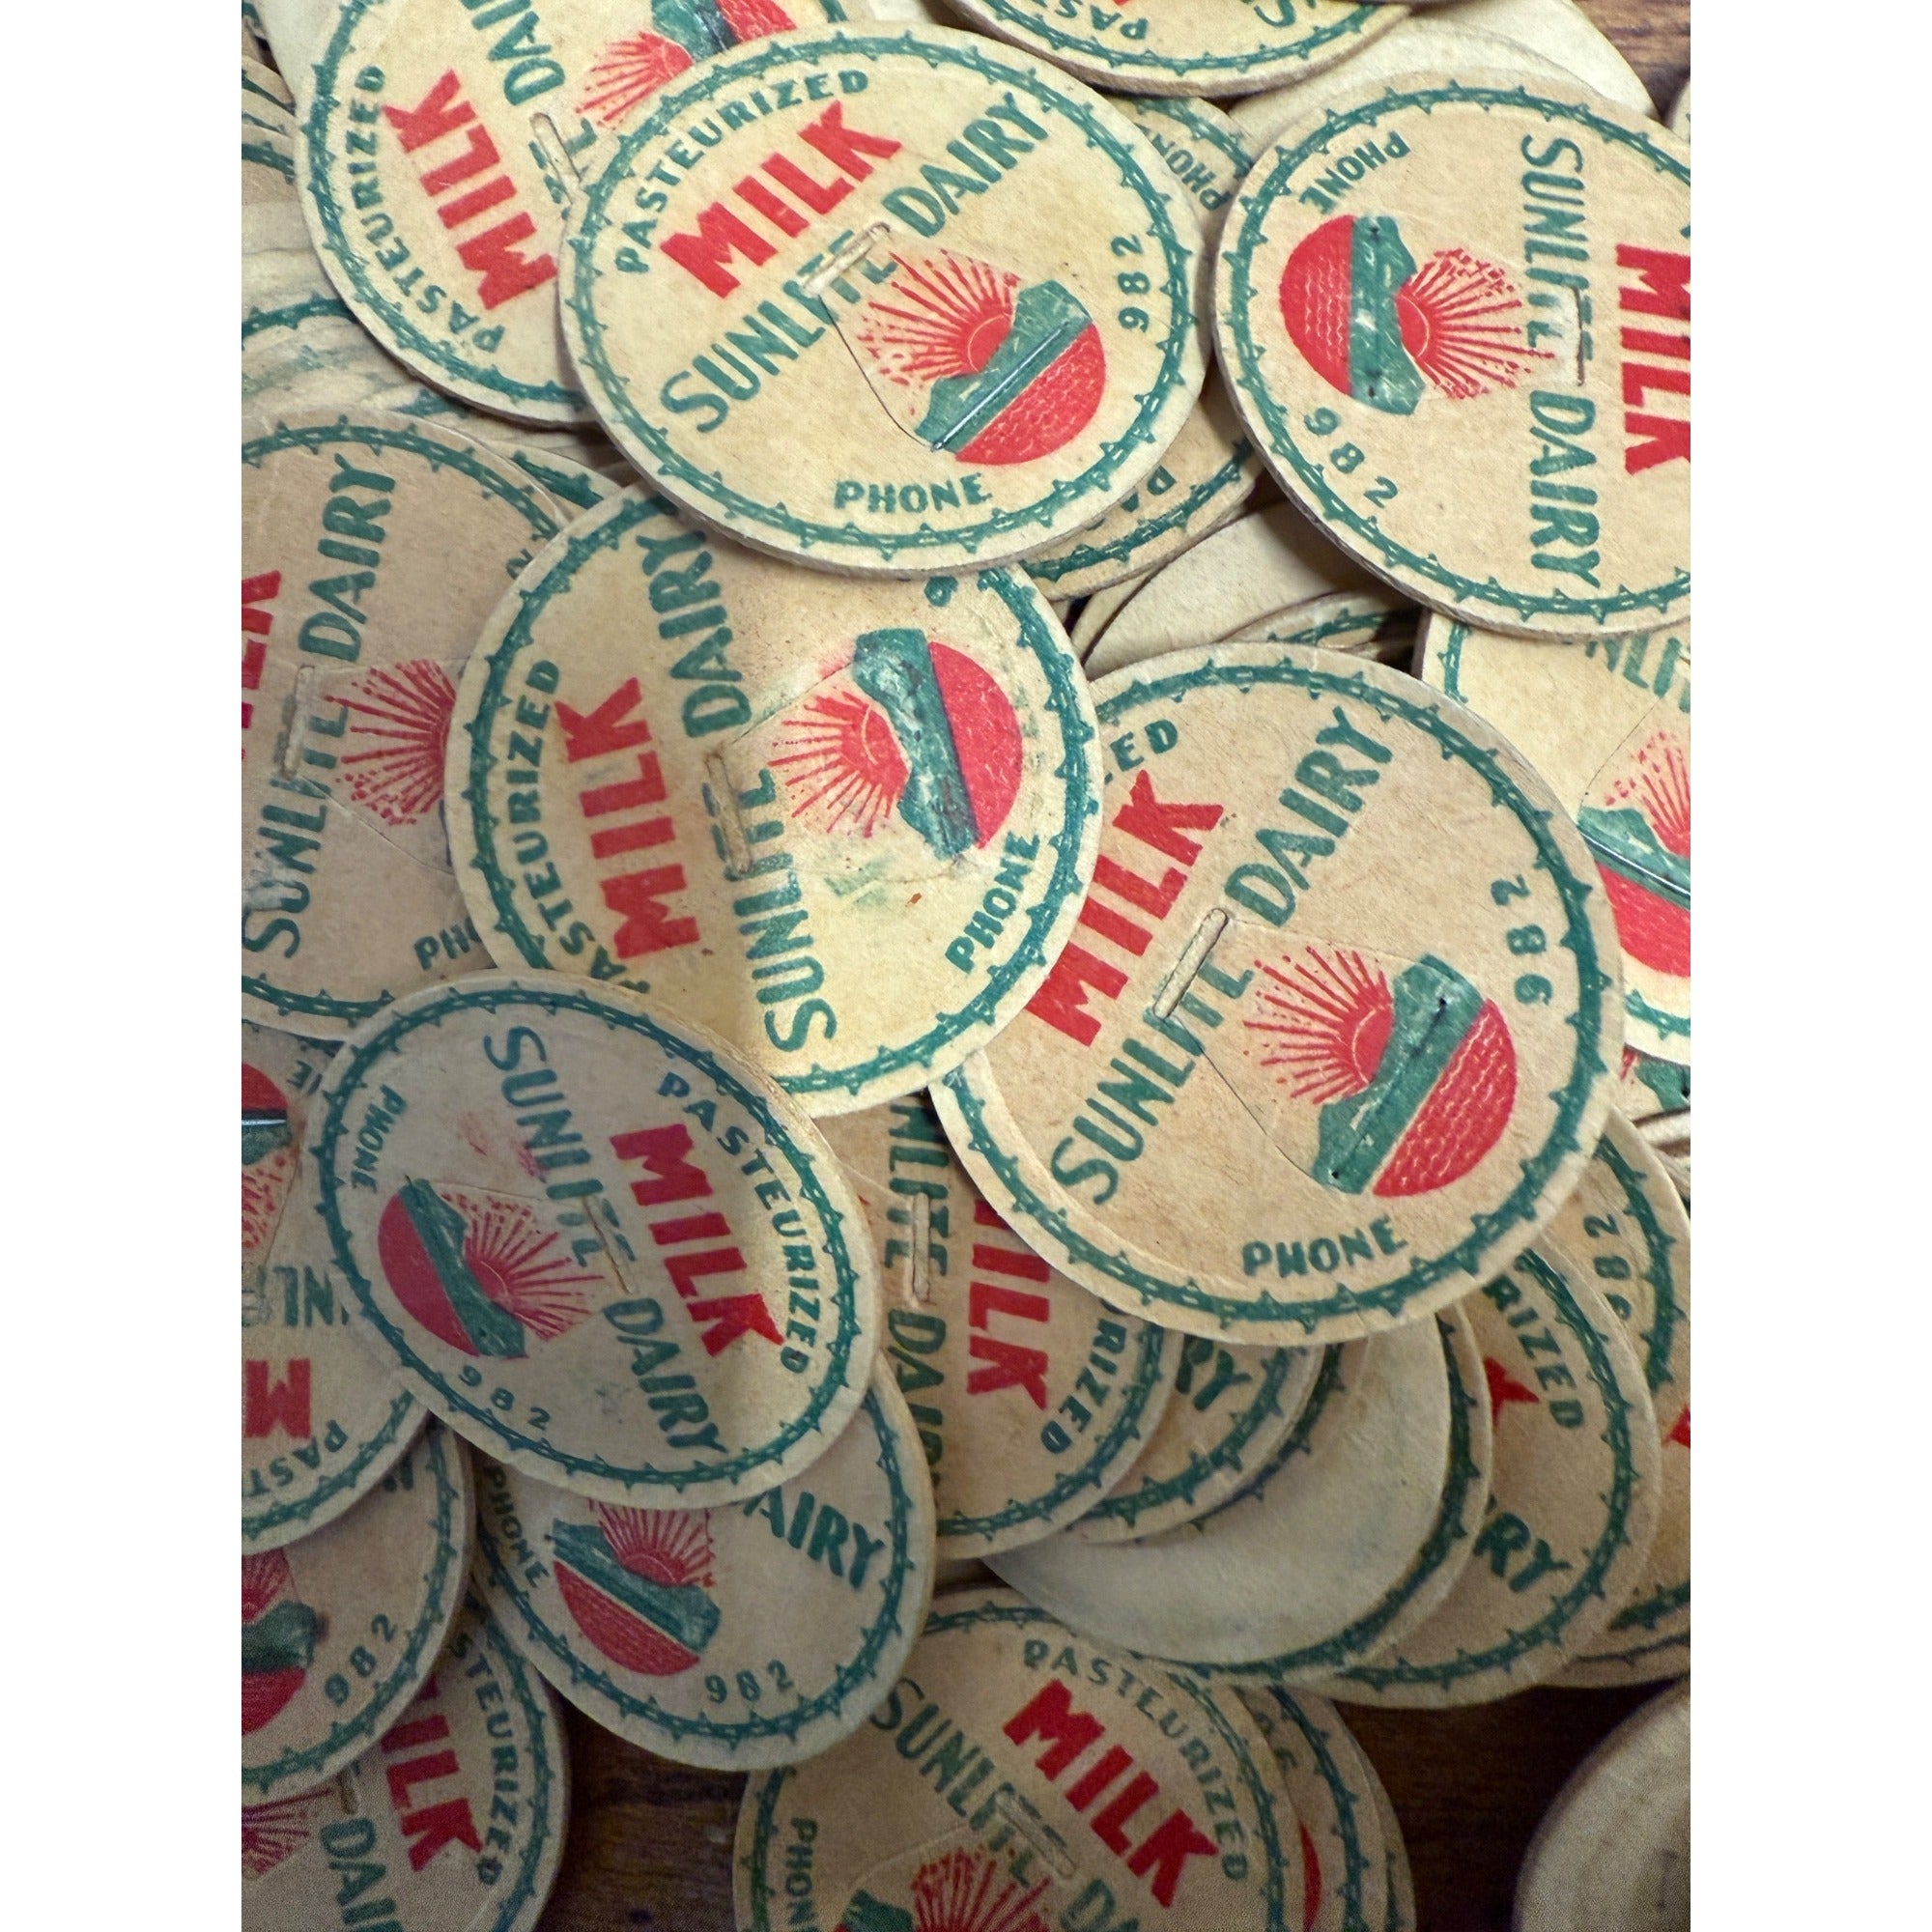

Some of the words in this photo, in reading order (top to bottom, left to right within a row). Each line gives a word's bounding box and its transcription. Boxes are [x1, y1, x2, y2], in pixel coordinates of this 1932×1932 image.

[461, 0, 566, 105] DAI
[346, 66, 507, 353] PASTEURIZED
[382, 69, 558, 310] MILK
[614, 70, 868, 273] PASTEURIZED
[660, 99, 902, 298] MILK
[660, 230, 896, 434] SUNLITE
[883, 92, 1048, 238] DAIRY
[1299, 130, 1410, 214] PHONE
[1520, 134, 1594, 361] SUNLITE
[1111, 232, 1150, 333] 982
[1615, 243, 1690, 475] MILK
[298, 453, 396, 662] DAIRY
[834, 473, 992, 514] PHONE
[1304, 407, 1398, 507] 982
[1529, 389, 1601, 588] DAIRY
[636, 531, 752, 738] DAIRY
[554, 677, 700, 959] MILK
[702, 768, 838, 1051] SUNLITE
[945, 832, 1040, 974] PHONE
[1025, 769, 1225, 1047] MILK
[1224, 706, 1393, 927] DAIRY
[1491, 874, 1552, 1006] 982
[351, 1084, 407, 1193] PHONE
[484, 1026, 635, 1266] SUNLITE
[602, 1297, 727, 1453] DAIRY
[609, 1123, 784, 1357] MILK
[658, 1071, 821, 1374] PASTEURIZED
[967, 1198, 1051, 1411] ILK
[1241, 1215, 1407, 1278] PHONE
[459, 1365, 552, 1431] 982
[484, 1465, 550, 1588] PHONE
[325, 1614, 396, 1706] 982
[704, 1659, 794, 1704] 982
[1023, 1639, 1248, 1881] PASTEURIZED
[381, 1675, 483, 1873] ILK
[1003, 1678, 1219, 1909] MILK
